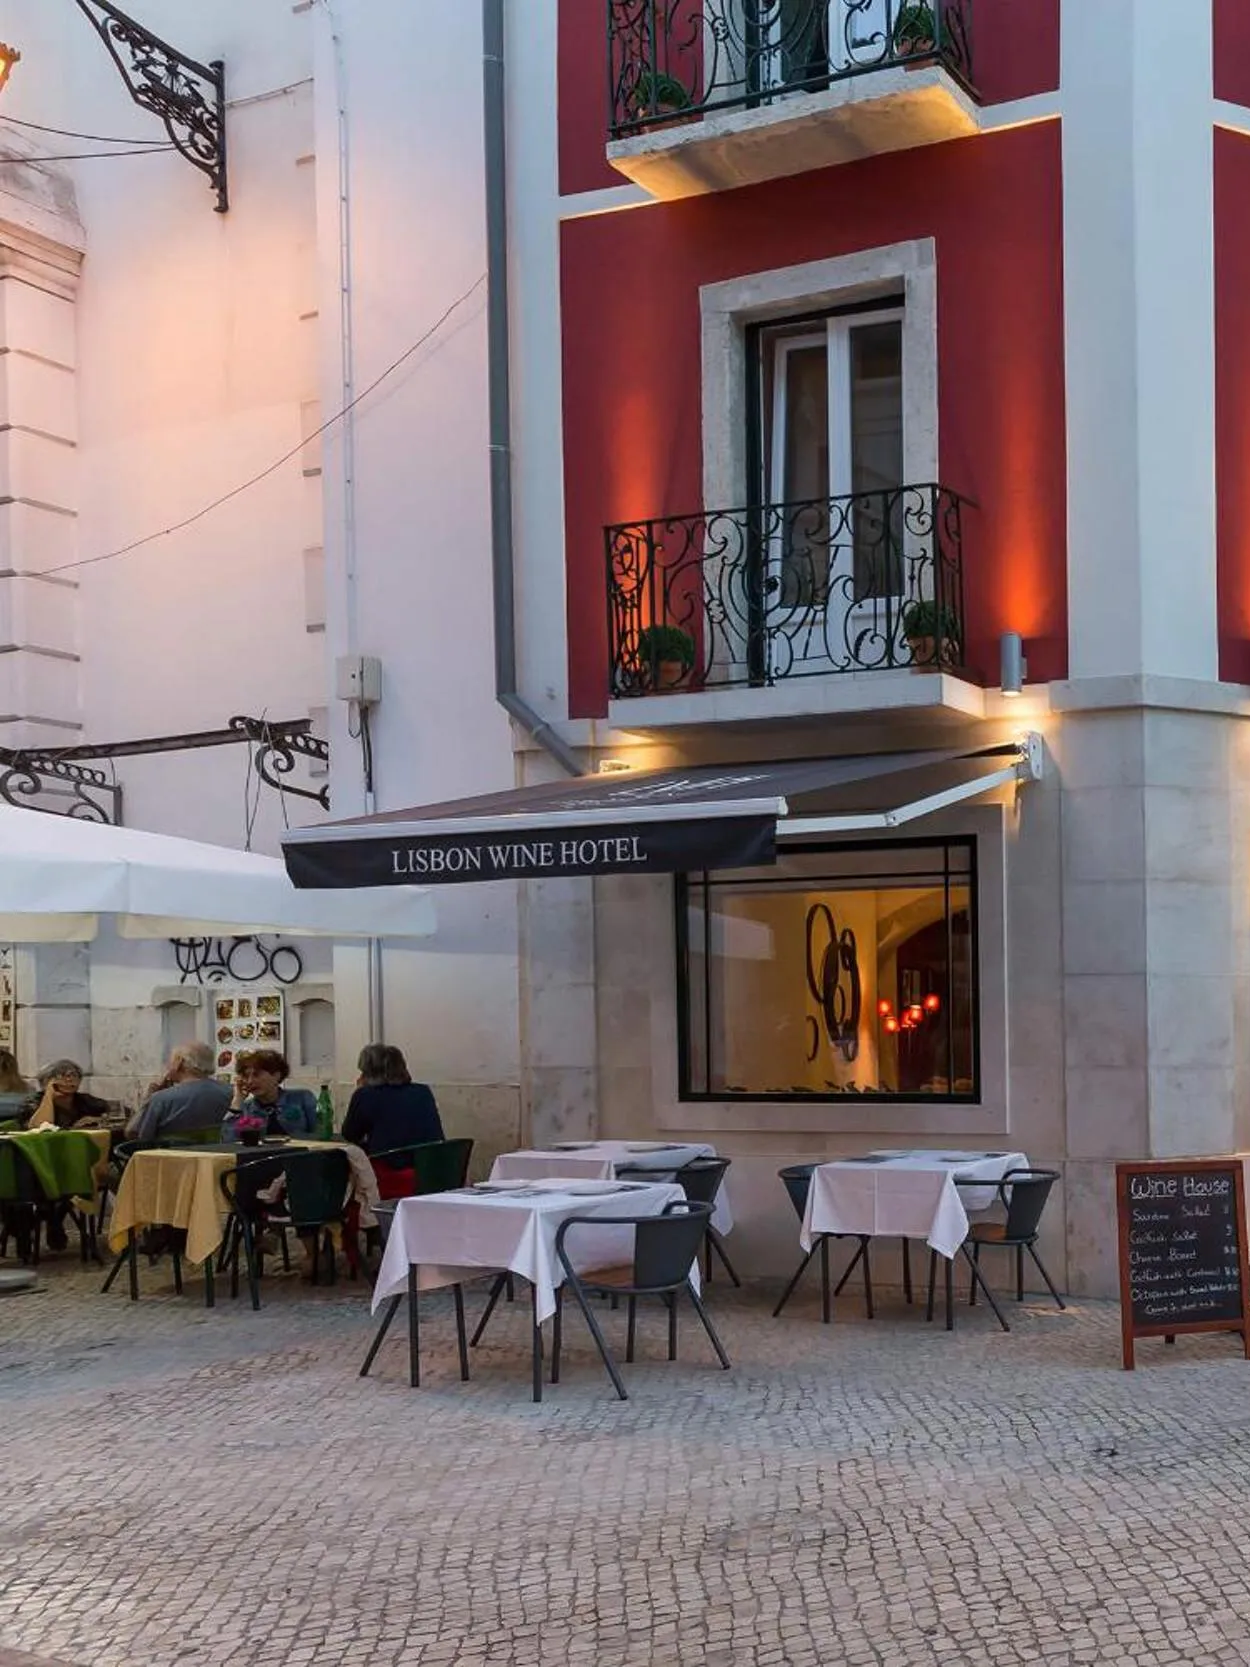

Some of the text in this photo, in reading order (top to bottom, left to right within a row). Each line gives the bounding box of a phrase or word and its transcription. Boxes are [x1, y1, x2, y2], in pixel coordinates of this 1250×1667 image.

[391, 836, 648, 874] LISBON WINE HOTEL
[1130, 1176, 1231, 1197] Wine House
